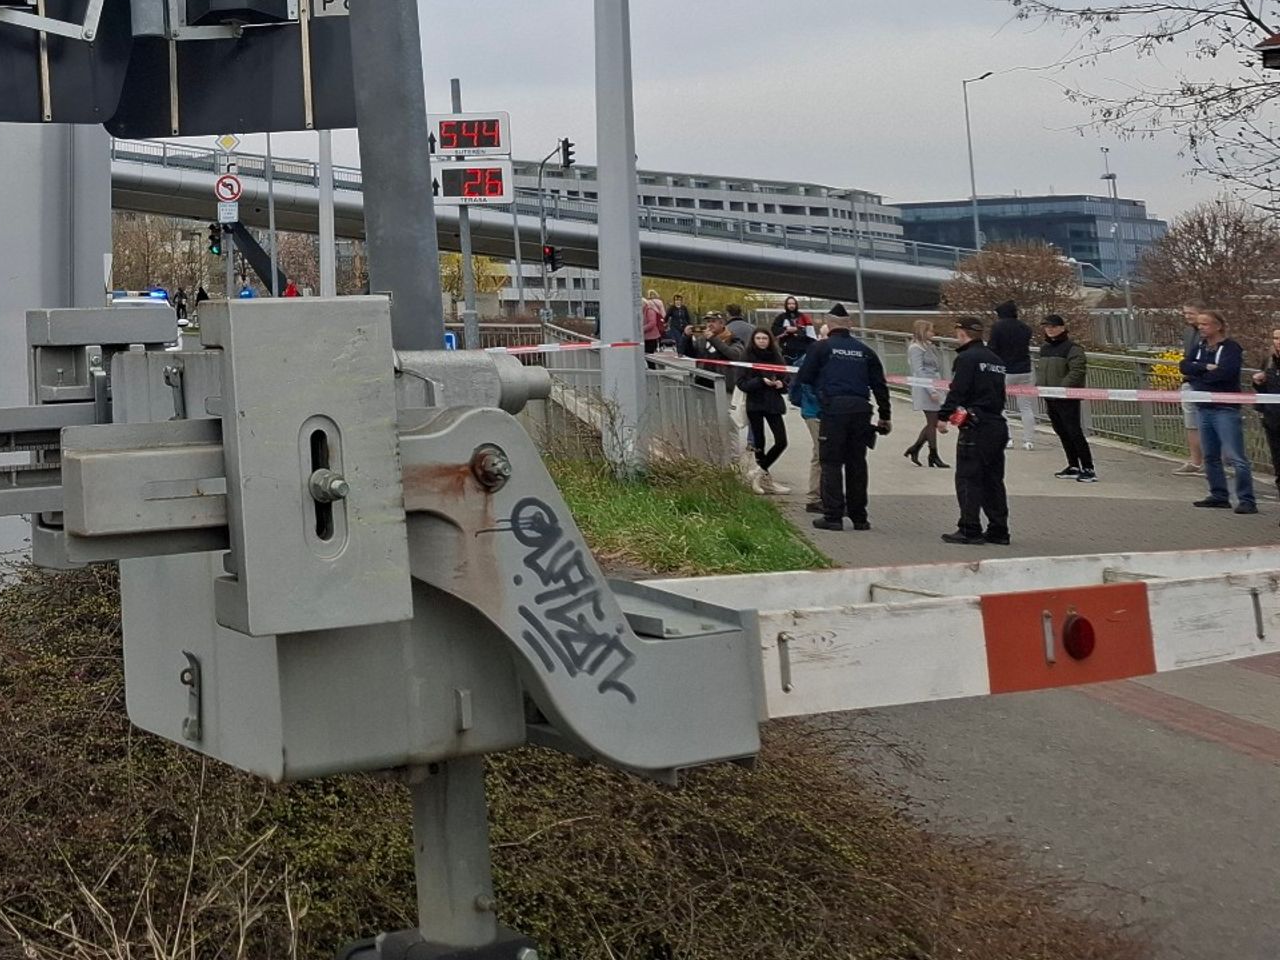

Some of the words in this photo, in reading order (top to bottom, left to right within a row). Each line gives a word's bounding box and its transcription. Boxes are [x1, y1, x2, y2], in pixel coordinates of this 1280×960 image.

[441, 121, 500, 148] 544
[464, 168, 503, 197] 26
[831, 348, 863, 358] POLICIE
